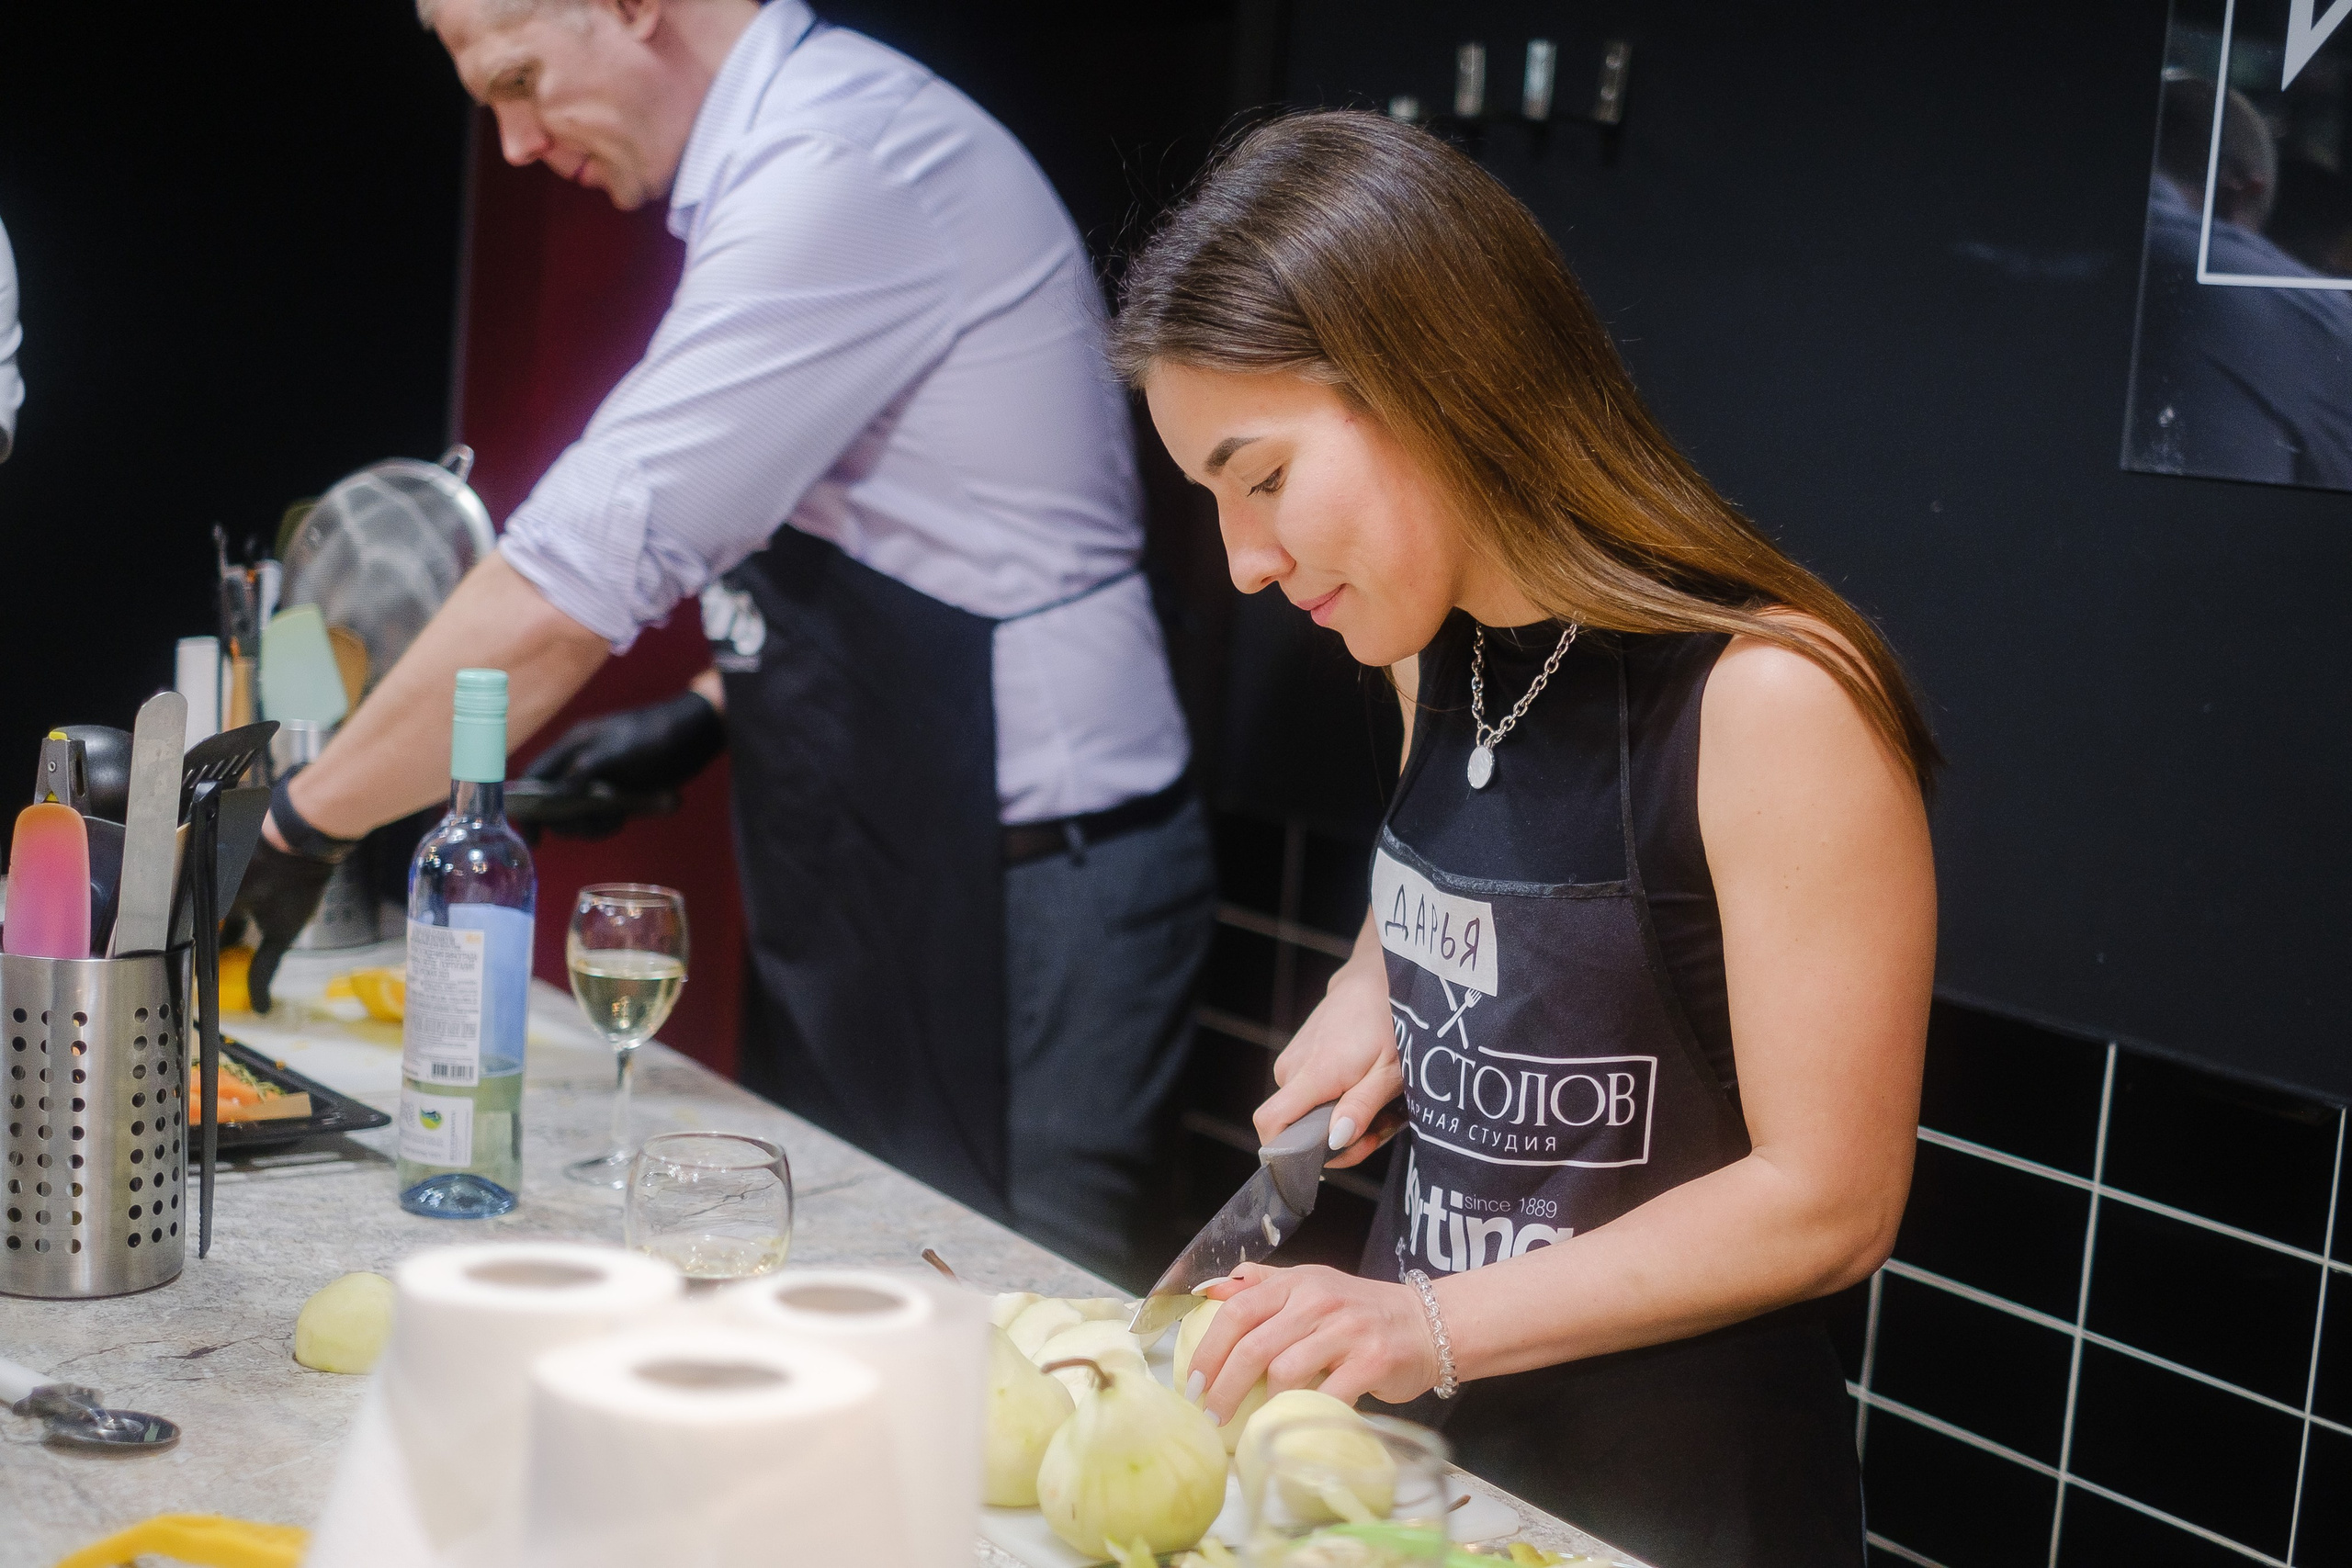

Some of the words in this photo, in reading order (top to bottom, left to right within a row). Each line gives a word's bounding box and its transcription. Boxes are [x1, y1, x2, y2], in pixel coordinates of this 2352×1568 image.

[1385, 884, 1480, 972] ДАРЬЯ
[1420, 1046, 1635, 1126] СТОЛОВ
[1468, 1124, 1556, 1153] СТУДИЯ
[1464, 1195, 1511, 1213] since
[1518, 1197, 1557, 1219] 1889
